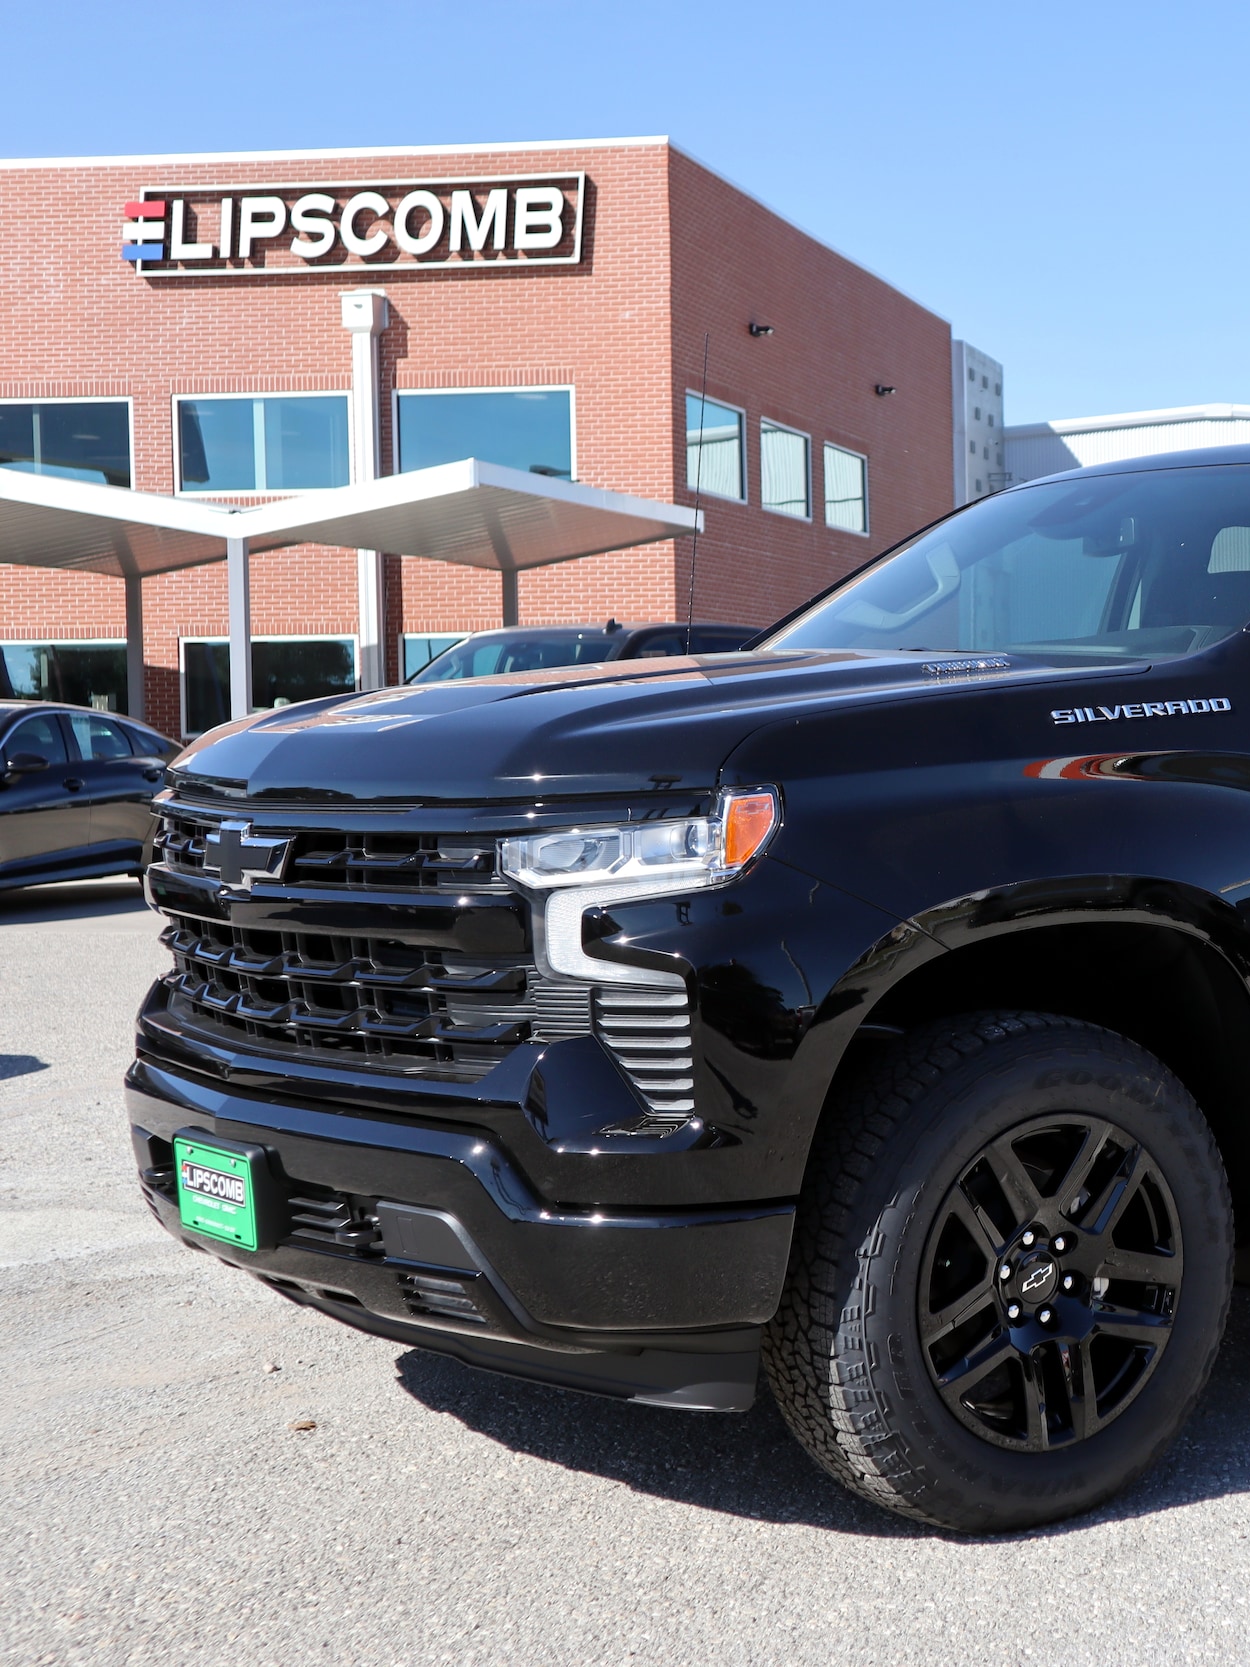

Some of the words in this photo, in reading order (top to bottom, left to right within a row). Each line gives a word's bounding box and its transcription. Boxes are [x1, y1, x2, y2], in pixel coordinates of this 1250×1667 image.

[169, 187, 565, 260] LIPSCOMB
[1050, 697, 1232, 725] SILVERADO
[187, 1166, 244, 1202] LIPSCOMB
